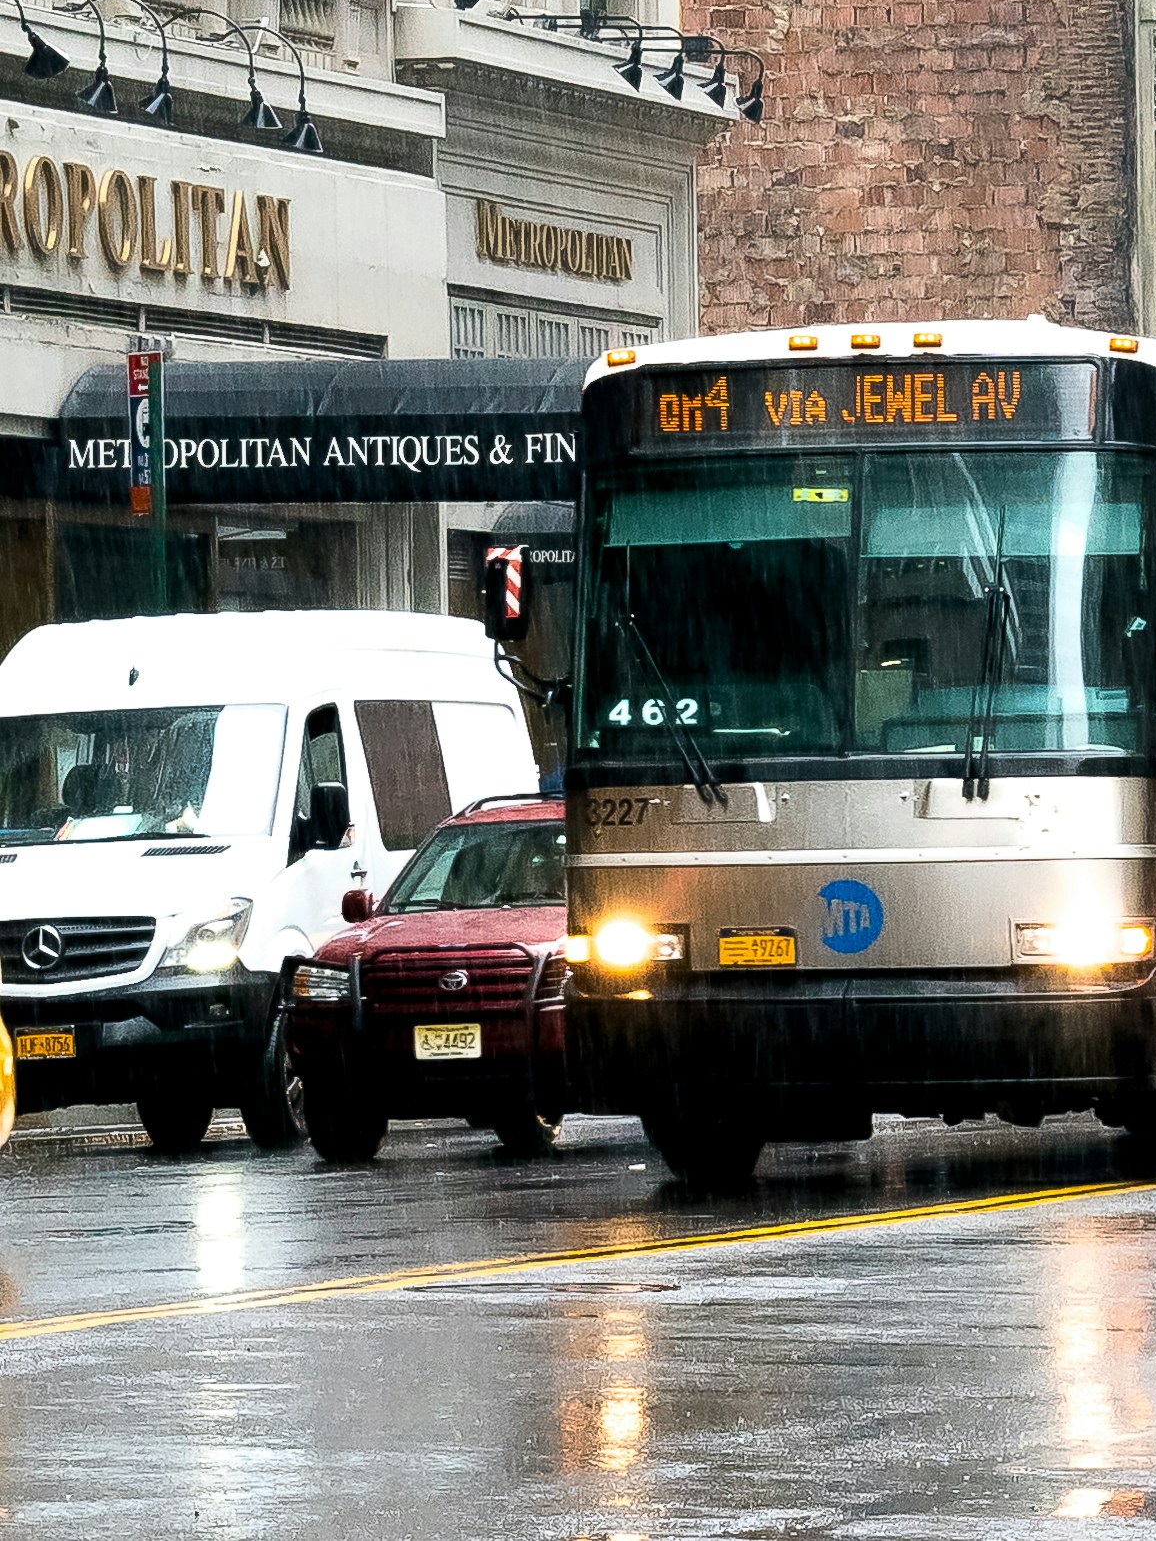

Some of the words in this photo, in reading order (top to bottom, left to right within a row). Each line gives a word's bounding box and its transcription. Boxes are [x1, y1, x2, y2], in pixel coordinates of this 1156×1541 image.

[475, 198, 634, 281] METROPOLITAN
[659, 375, 730, 432] QM4
[764, 390, 827, 427] VIA
[841, 372, 959, 424] JEWEL
[971, 370, 1022, 421] AV
[68, 437, 312, 469] METOPOLITAN
[322, 434, 480, 473] ANTIQUES
[489, 433, 514, 466] &
[608, 698, 699, 726] 462
[822, 897, 871, 938] MTA
